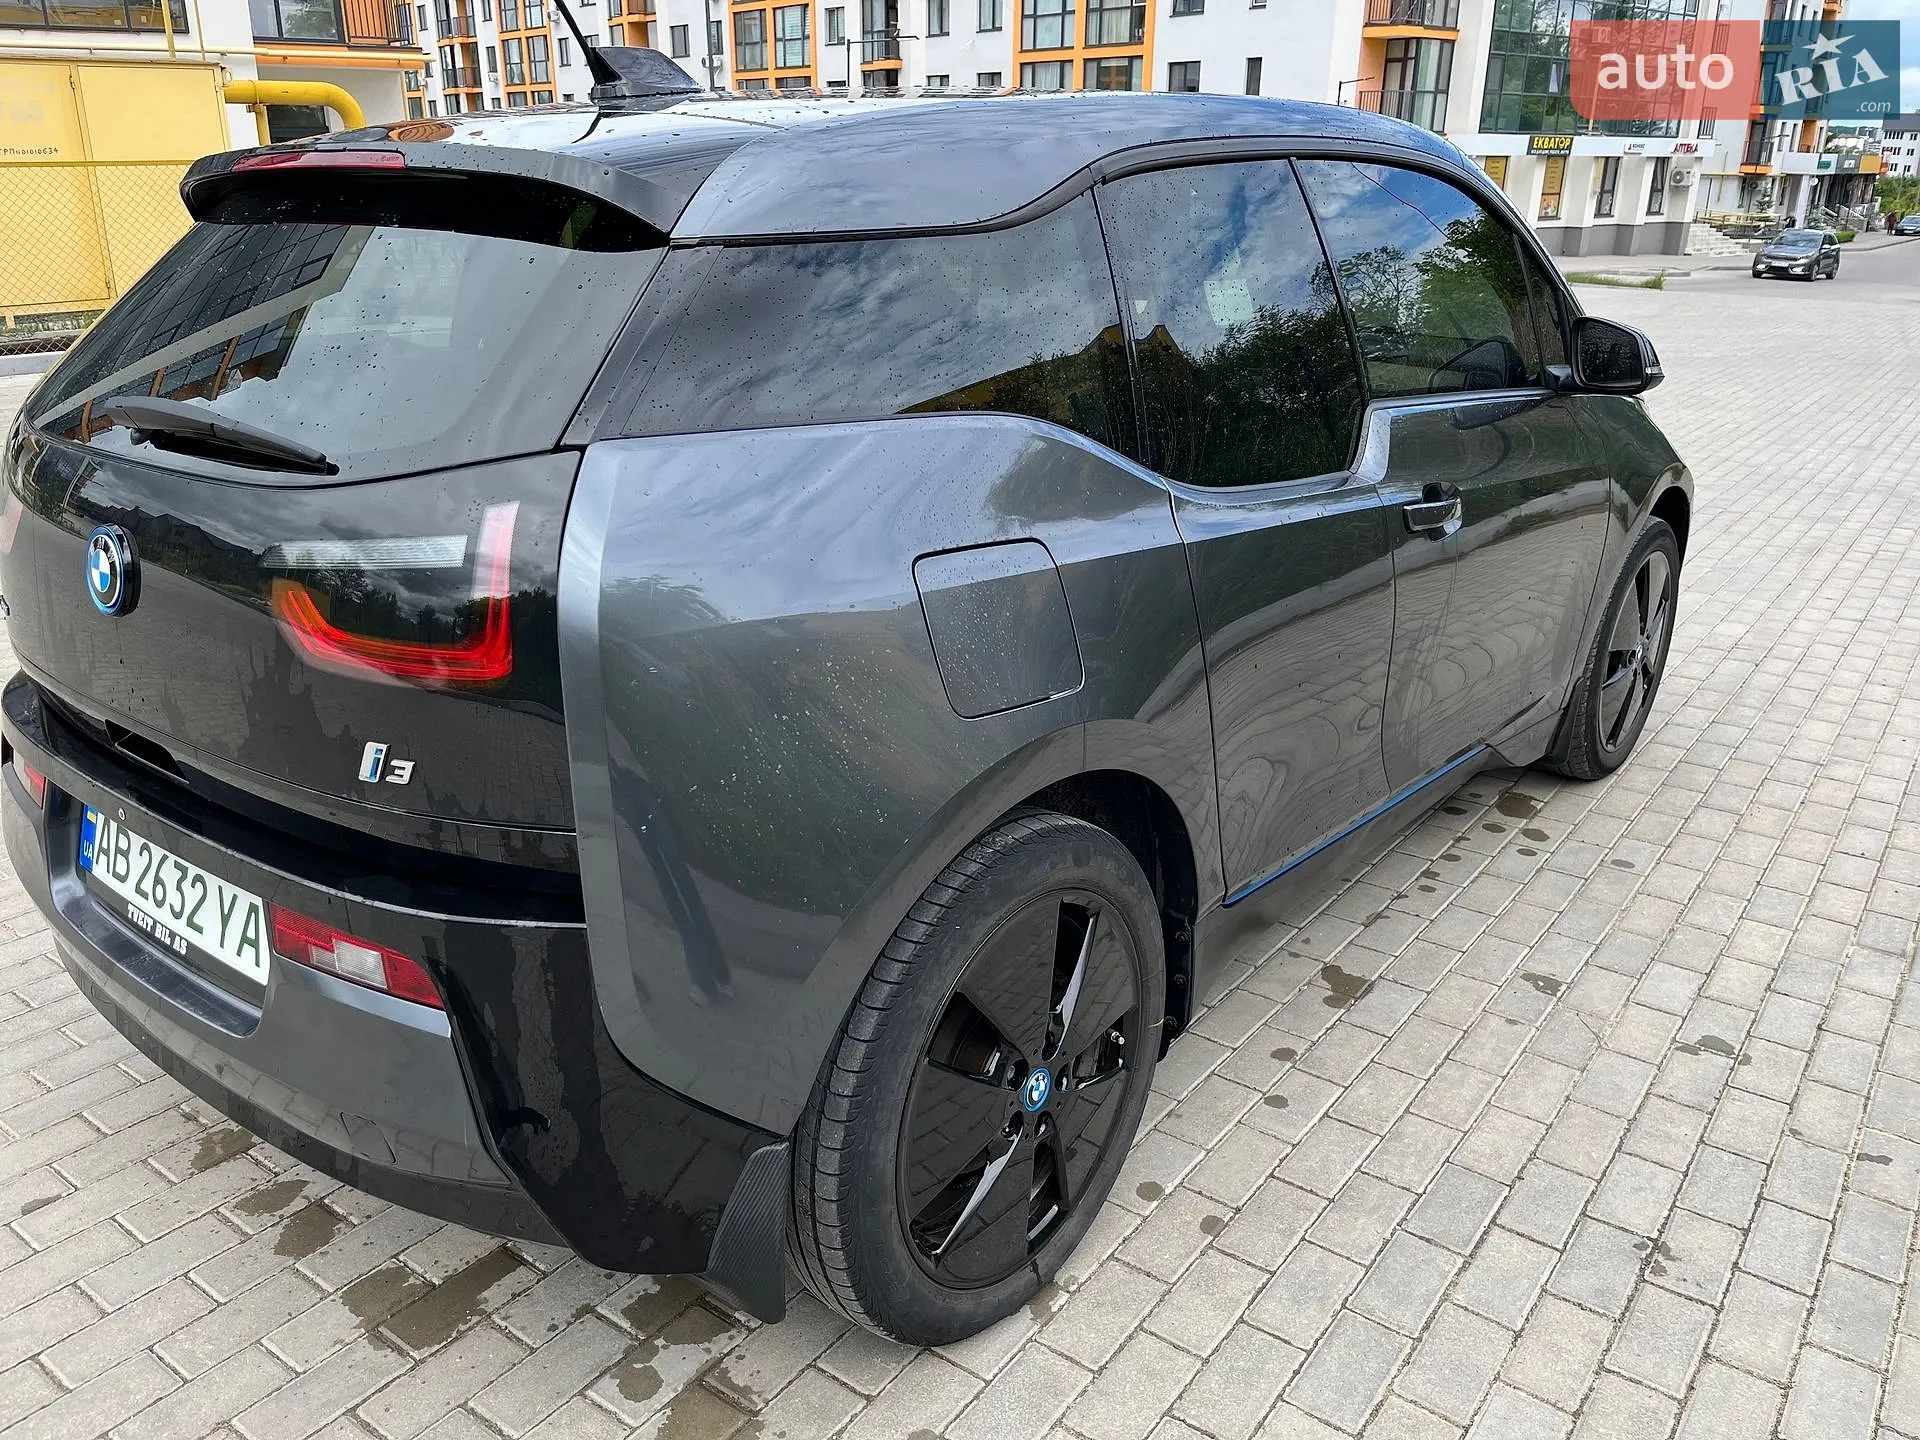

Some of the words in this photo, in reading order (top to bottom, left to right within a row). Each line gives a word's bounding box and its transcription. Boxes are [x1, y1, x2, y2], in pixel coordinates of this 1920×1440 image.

[1532, 136, 1571, 149] ЕКВАТОР
[358, 741, 415, 785] i3
[83, 840, 93, 859] UA
[95, 815, 132, 884] AB
[134, 841, 208, 936] 2632
[217, 884, 261, 968] YA
[127, 902, 154, 932] TVEIT
[154, 922, 171, 945] BIL
[172, 934, 188, 955] AS
